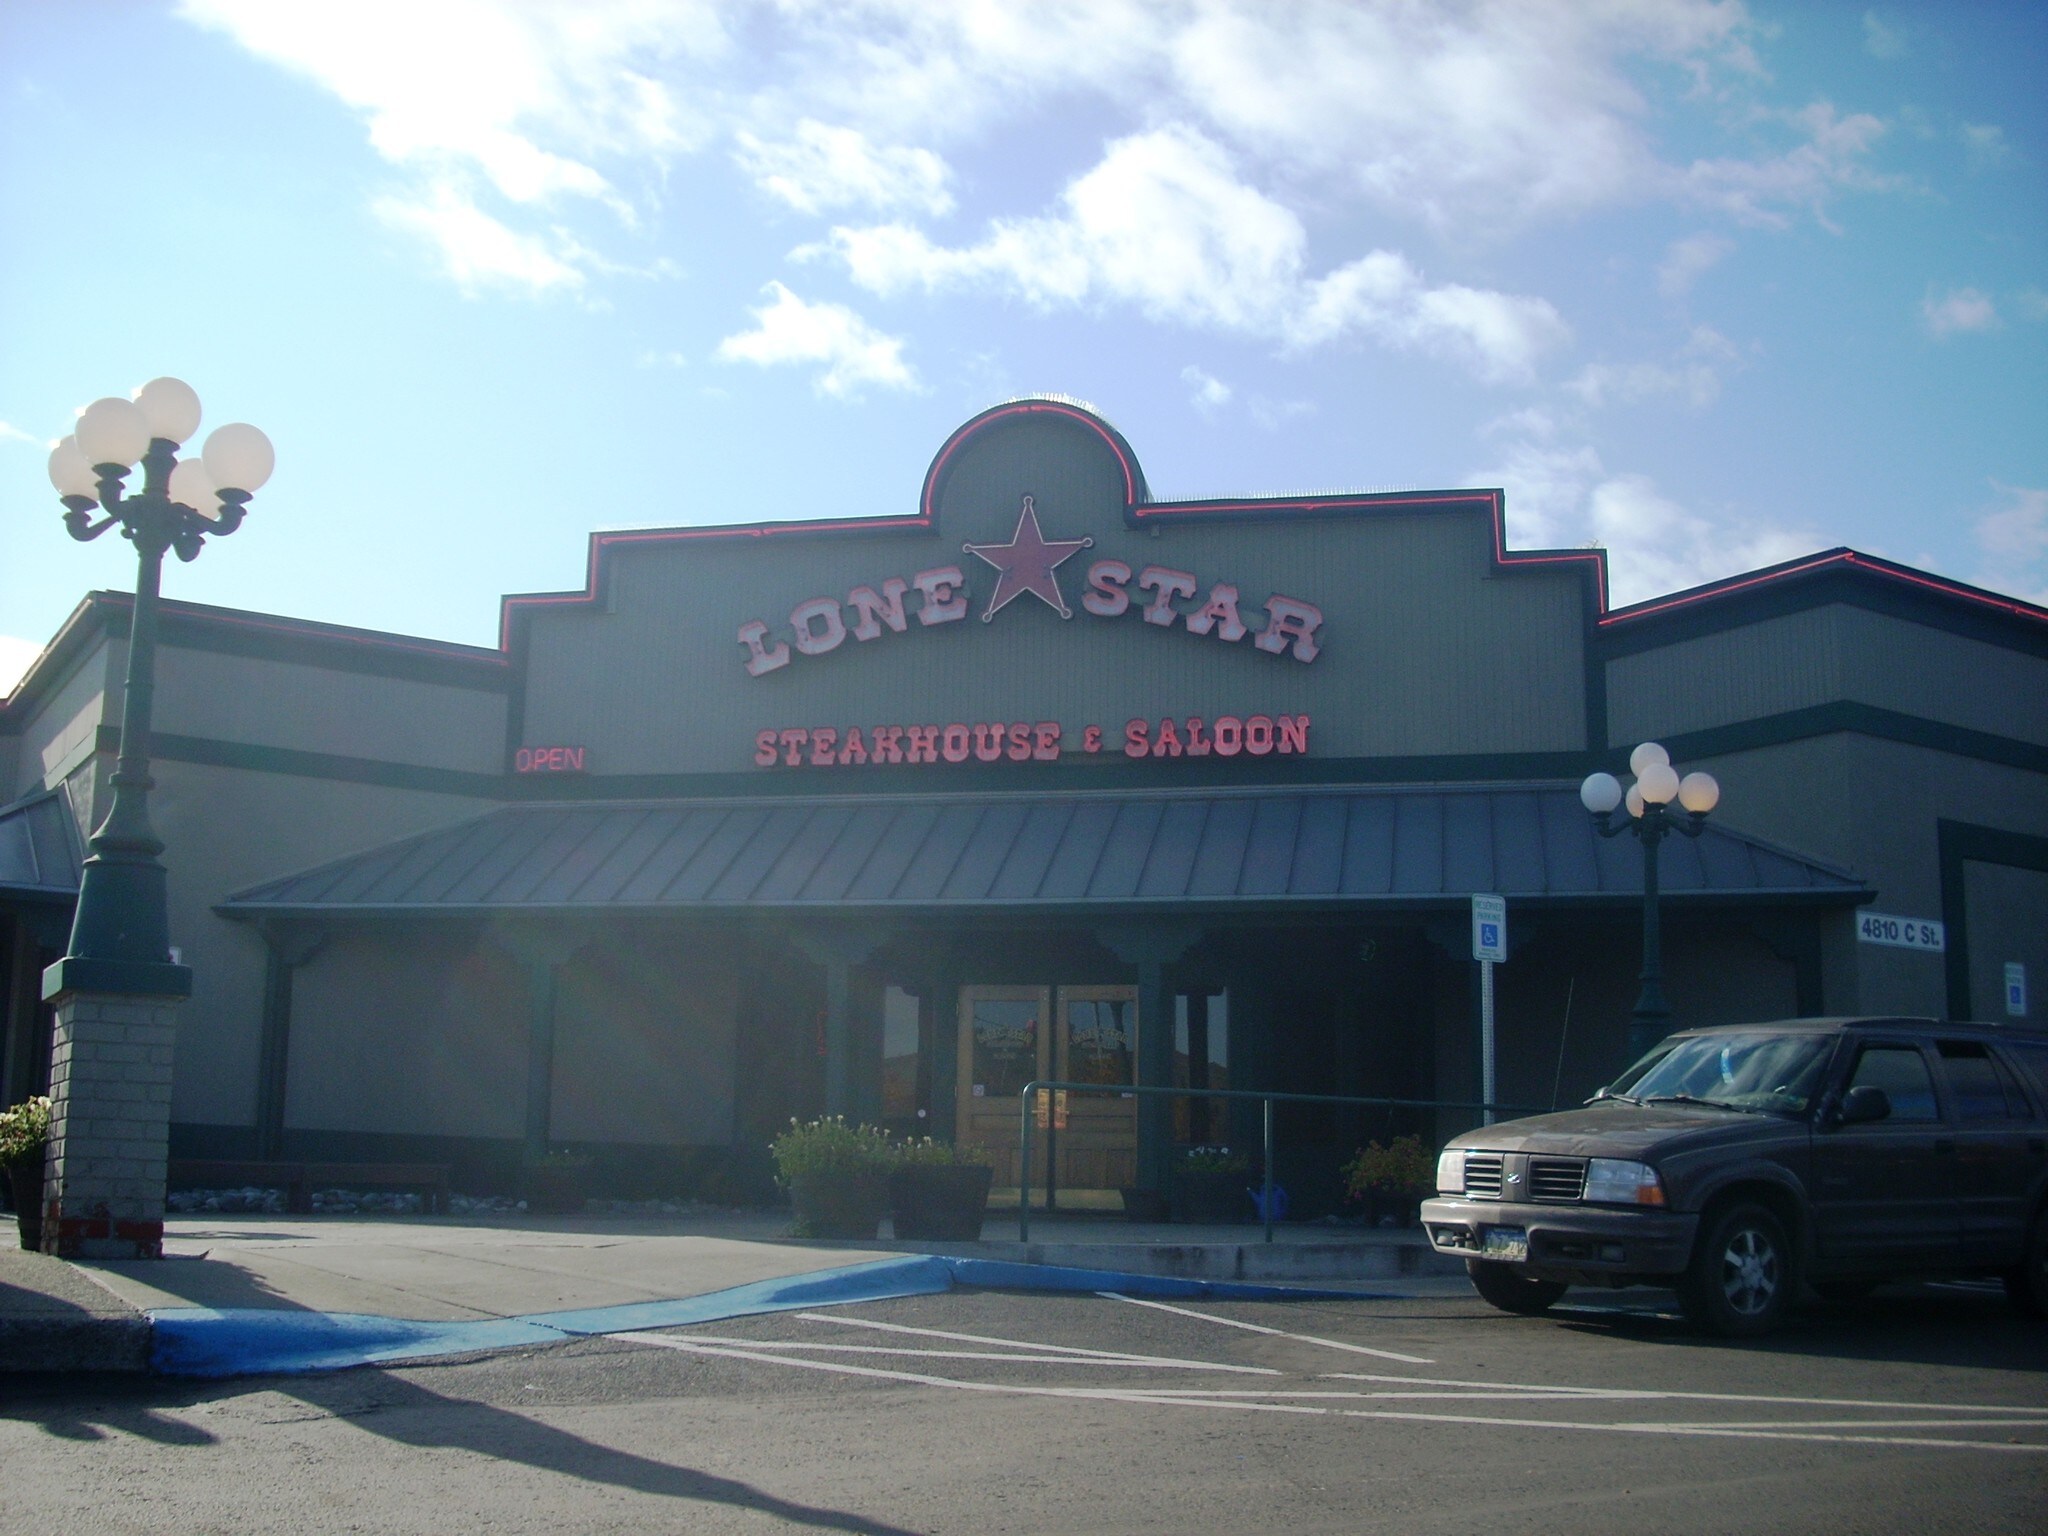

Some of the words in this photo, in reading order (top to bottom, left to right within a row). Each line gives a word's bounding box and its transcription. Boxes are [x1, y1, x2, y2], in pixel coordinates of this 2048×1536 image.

[737, 565, 968, 677] LONE
[1081, 560, 1323, 664] STAR
[515, 746, 585, 773] OPEN
[755, 722, 1060, 766] STEAKHOUSE
[1083, 725, 1101, 753] &
[1124, 714, 1310, 758] SALOON
[1862, 917, 1898, 940] 4810
[1904, 922, 1915, 943] C
[1920, 925, 1940, 946] St.
